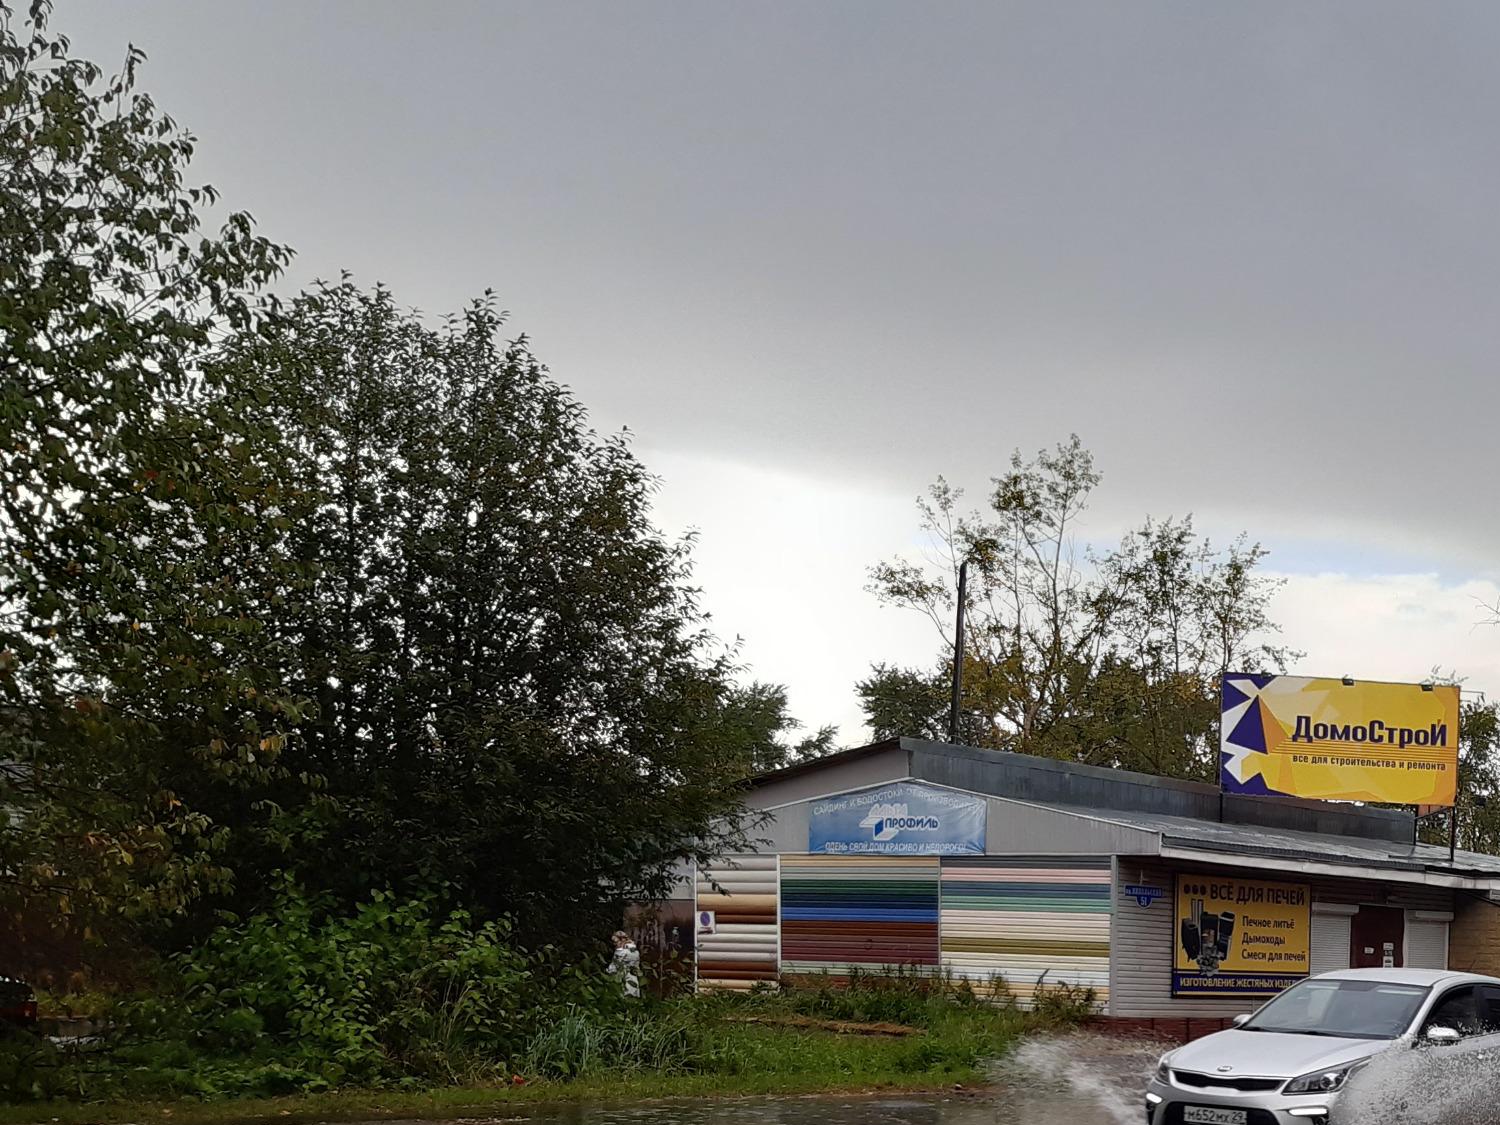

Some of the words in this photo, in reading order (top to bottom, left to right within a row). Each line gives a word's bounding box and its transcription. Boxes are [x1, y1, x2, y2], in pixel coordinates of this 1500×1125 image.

[1292, 754, 1309, 763] все
[1311, 756, 1328, 765] для
[1330, 757, 1396, 768] строительства
[1399, 761, 1405, 769] и
[1407, 761, 1446, 771] ремонта
[813, 801, 847, 816] САЙДИНГ
[856, 788, 903, 806] ВОДОСТОКИ
[884, 817, 939, 829] ПРОФИЛЬ
[825, 842, 848, 851] ОДЕНЬ
[849, 841, 868, 851] СВОЙ
[868, 842, 885, 851] ДОМ
[886, 842, 918, 851] КРАСИВО
[919, 842, 925, 851] И
[1210, 881, 1234, 900] ВСЁ
[1236, 886, 1264, 905] ДЛЯ
[1267, 887, 1305, 906] ПЕЧЕЙ
[1140, 896, 1147, 905] 51
[1242, 916, 1271, 928] Печное
[1273, 918, 1295, 929] литьё
[1241, 932, 1286, 946] Дымоходы
[1241, 948, 1267, 960] Смеси
[1267, 951, 1283, 962] для
[1283, 950, 1306, 962] печей
[1180, 977, 1236, 988] ИЗГОТОВЛЕНИЕ
[1236, 978, 1274, 989] ЖЕСТЯНЫХ
[1275, 979, 1297, 988] ИЗДЕ
